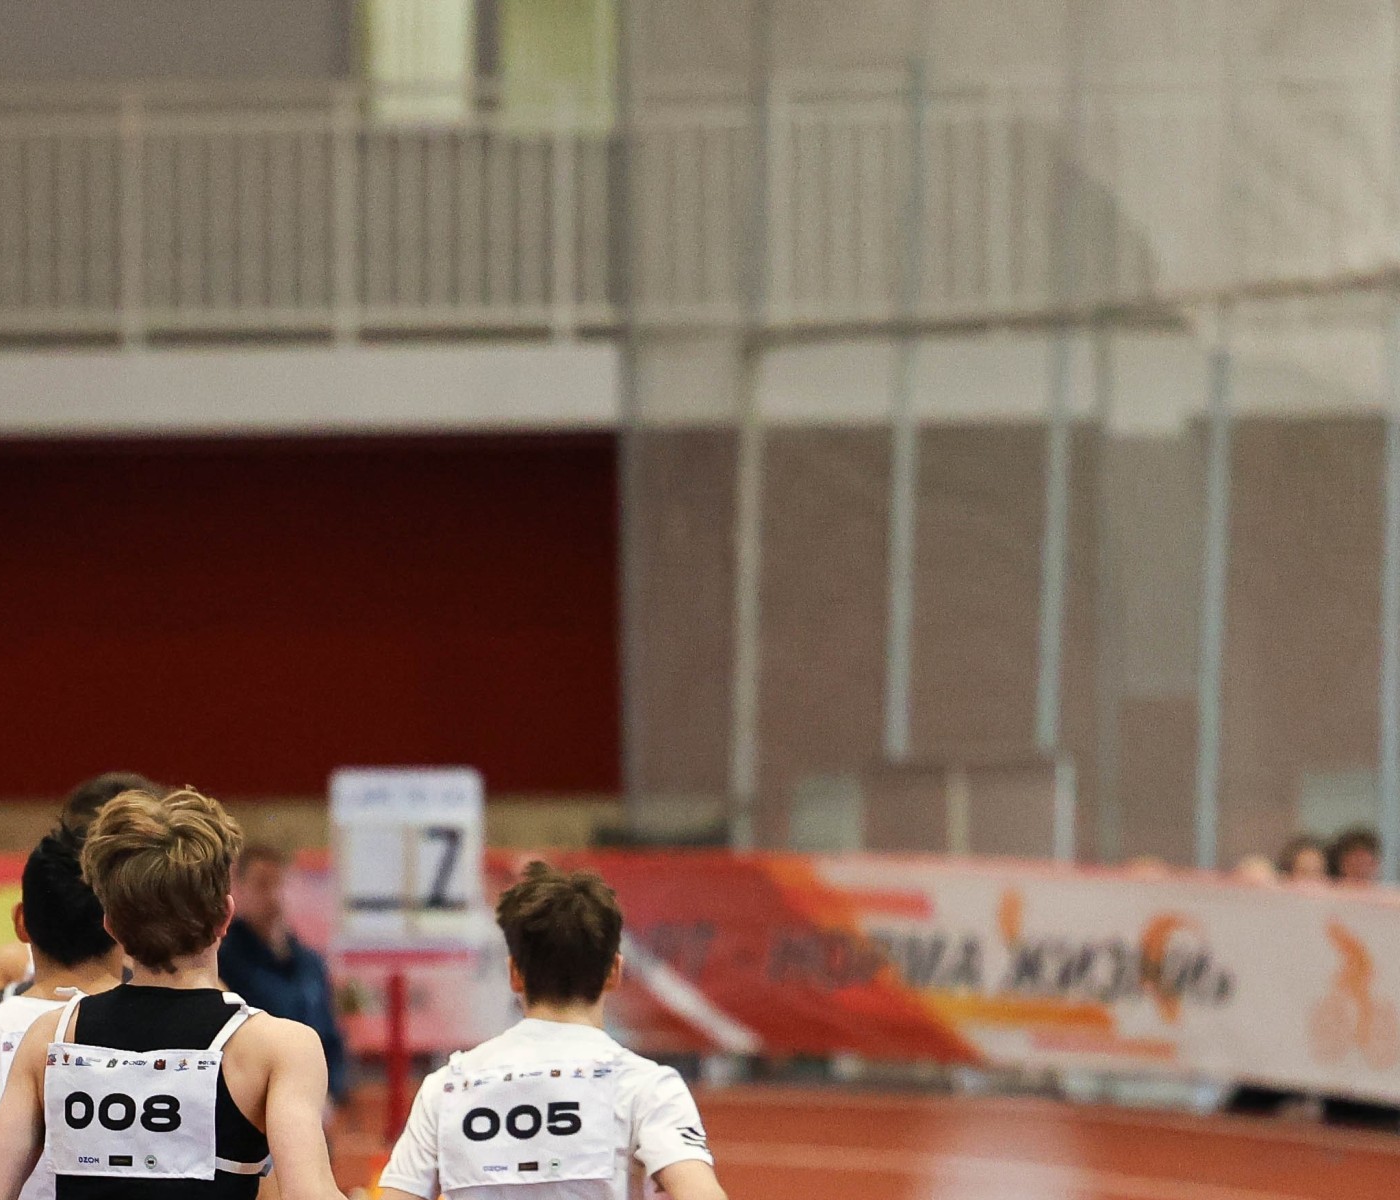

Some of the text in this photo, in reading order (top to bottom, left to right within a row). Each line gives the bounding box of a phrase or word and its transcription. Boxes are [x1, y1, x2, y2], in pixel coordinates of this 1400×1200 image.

[426, 826, 464, 909] 7
[64, 1091, 182, 1132] 008
[462, 1101, 582, 1141] 005
[78, 1156, 100, 1164] OZON
